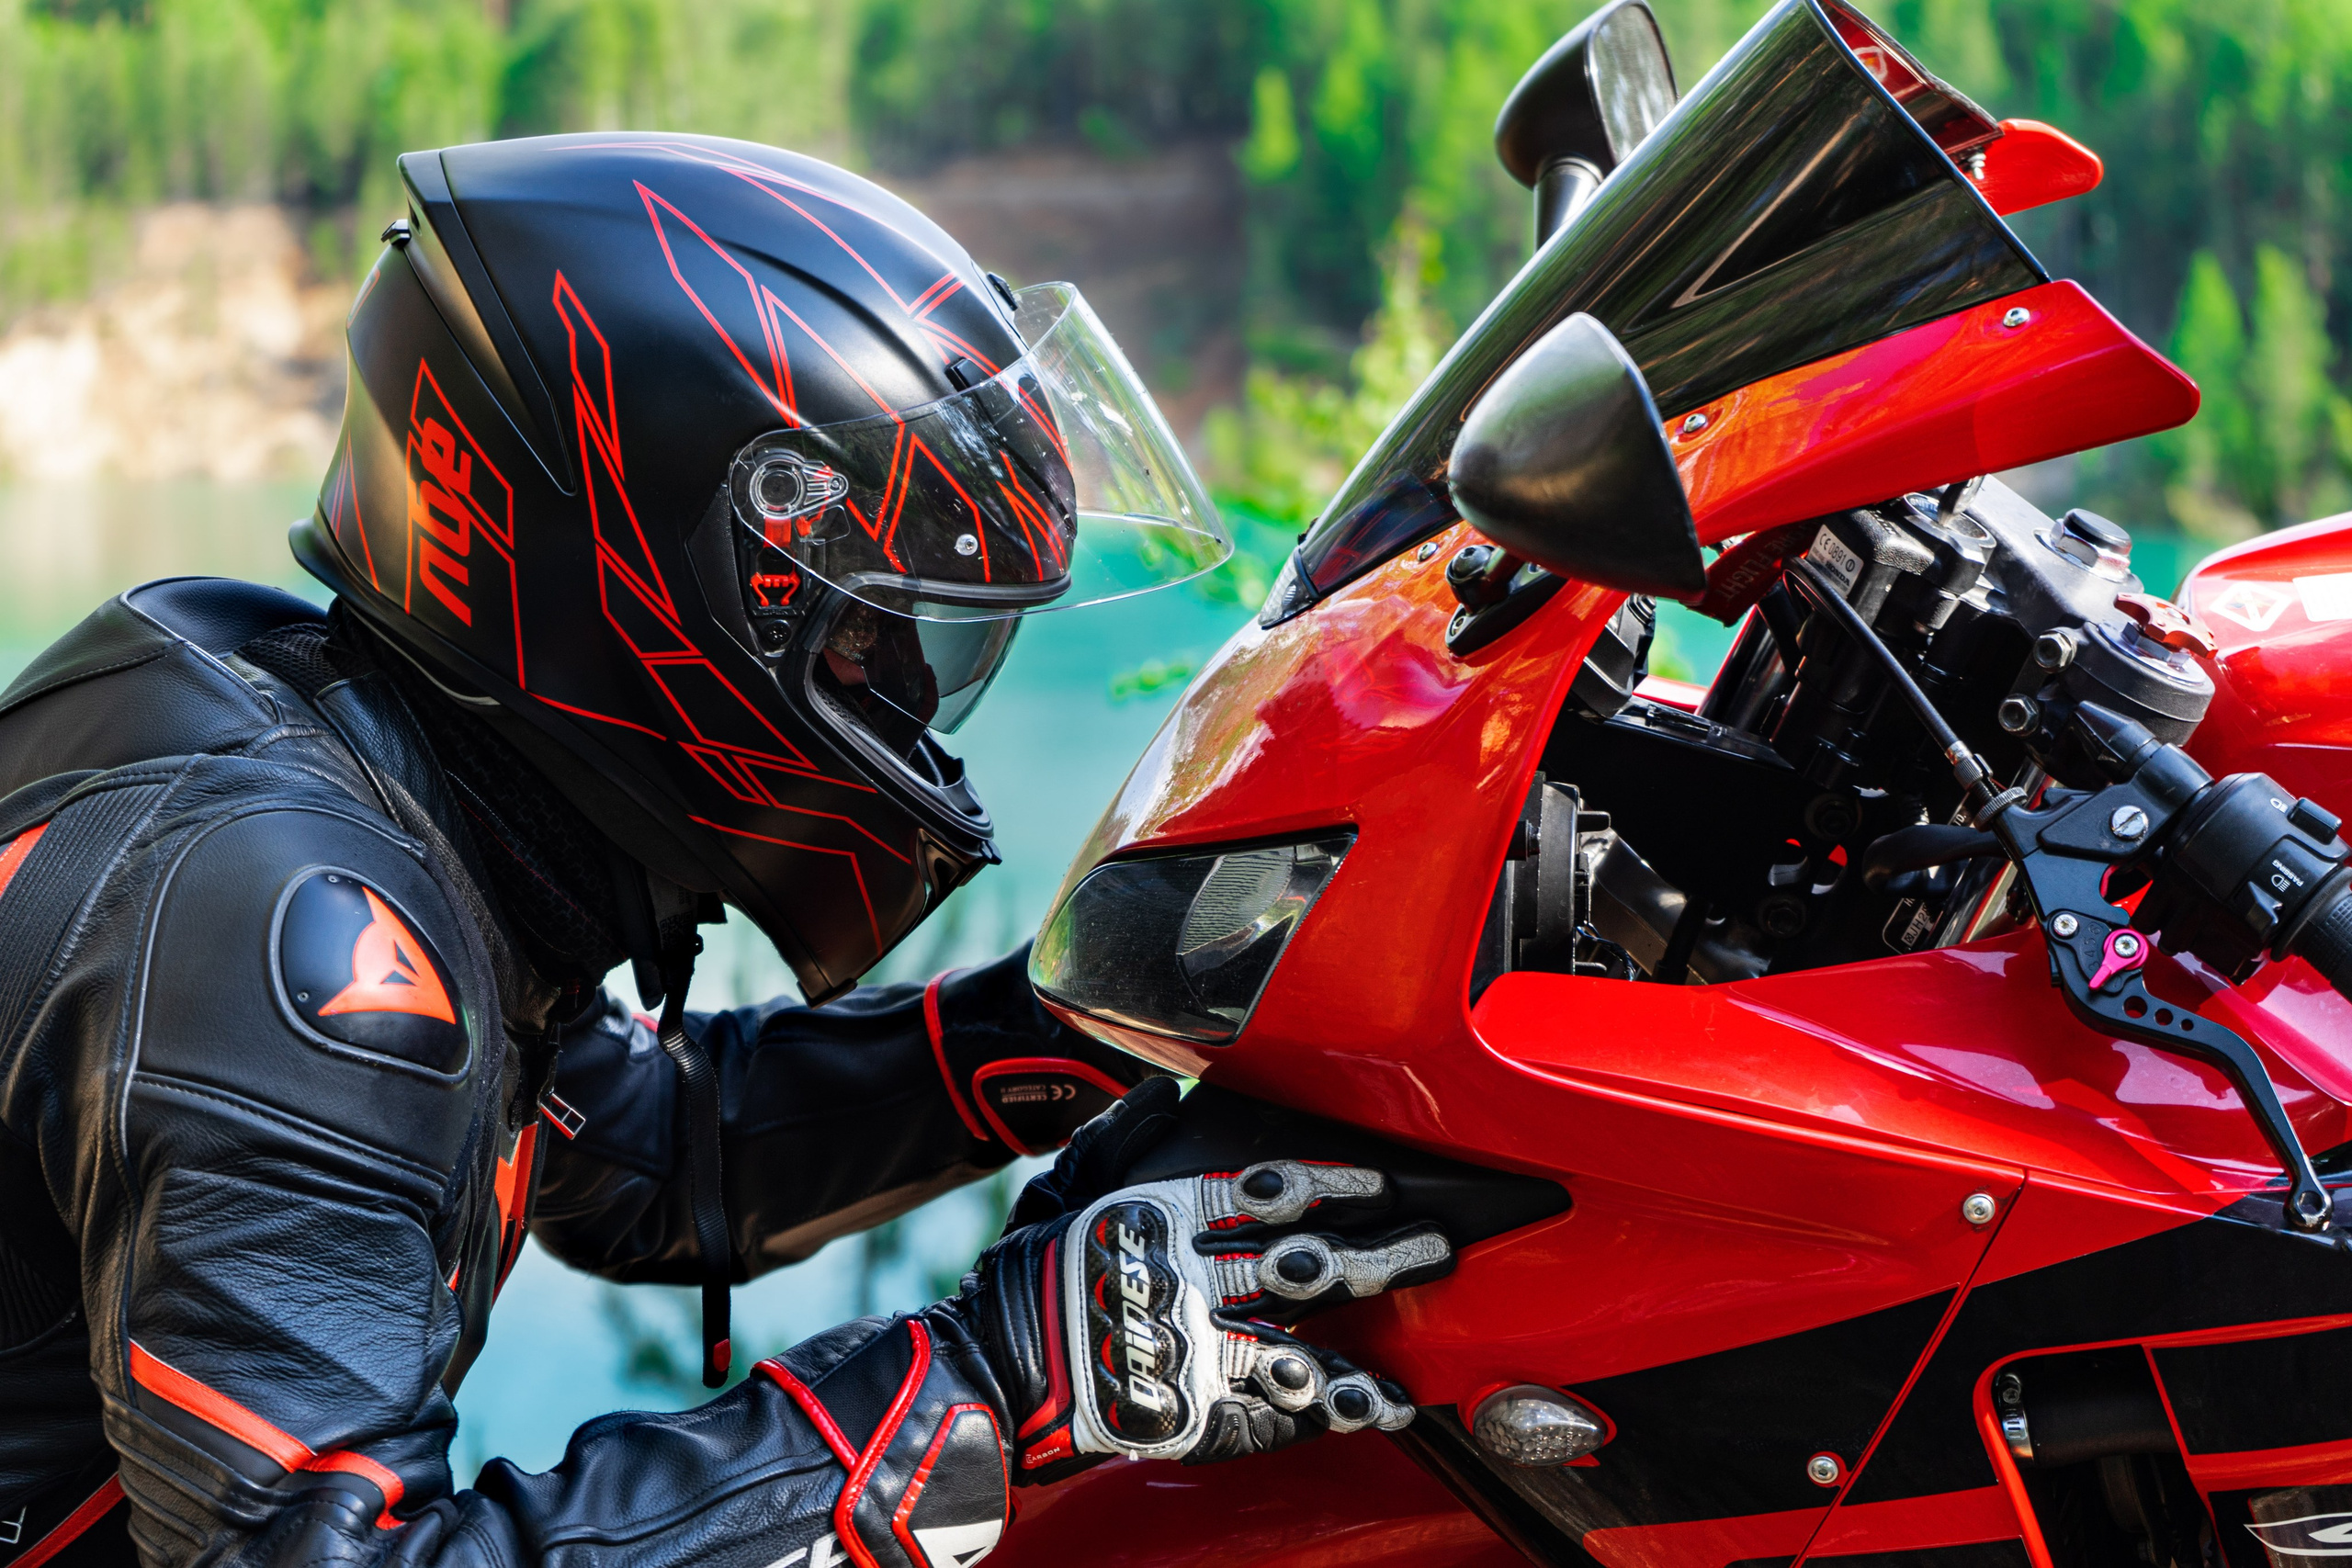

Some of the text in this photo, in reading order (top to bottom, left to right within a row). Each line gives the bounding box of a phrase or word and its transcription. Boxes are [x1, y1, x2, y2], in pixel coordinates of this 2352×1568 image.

[1825, 560, 1850, 587] HONDA
[1953, 814, 1967, 827] TD.
[2271, 859, 2304, 887] PASSING
[1001, 1094, 1047, 1103] CERTIFIED
[1118, 1223, 1161, 1412] DAINESE
[1025, 1447, 1061, 1464] CARBON
